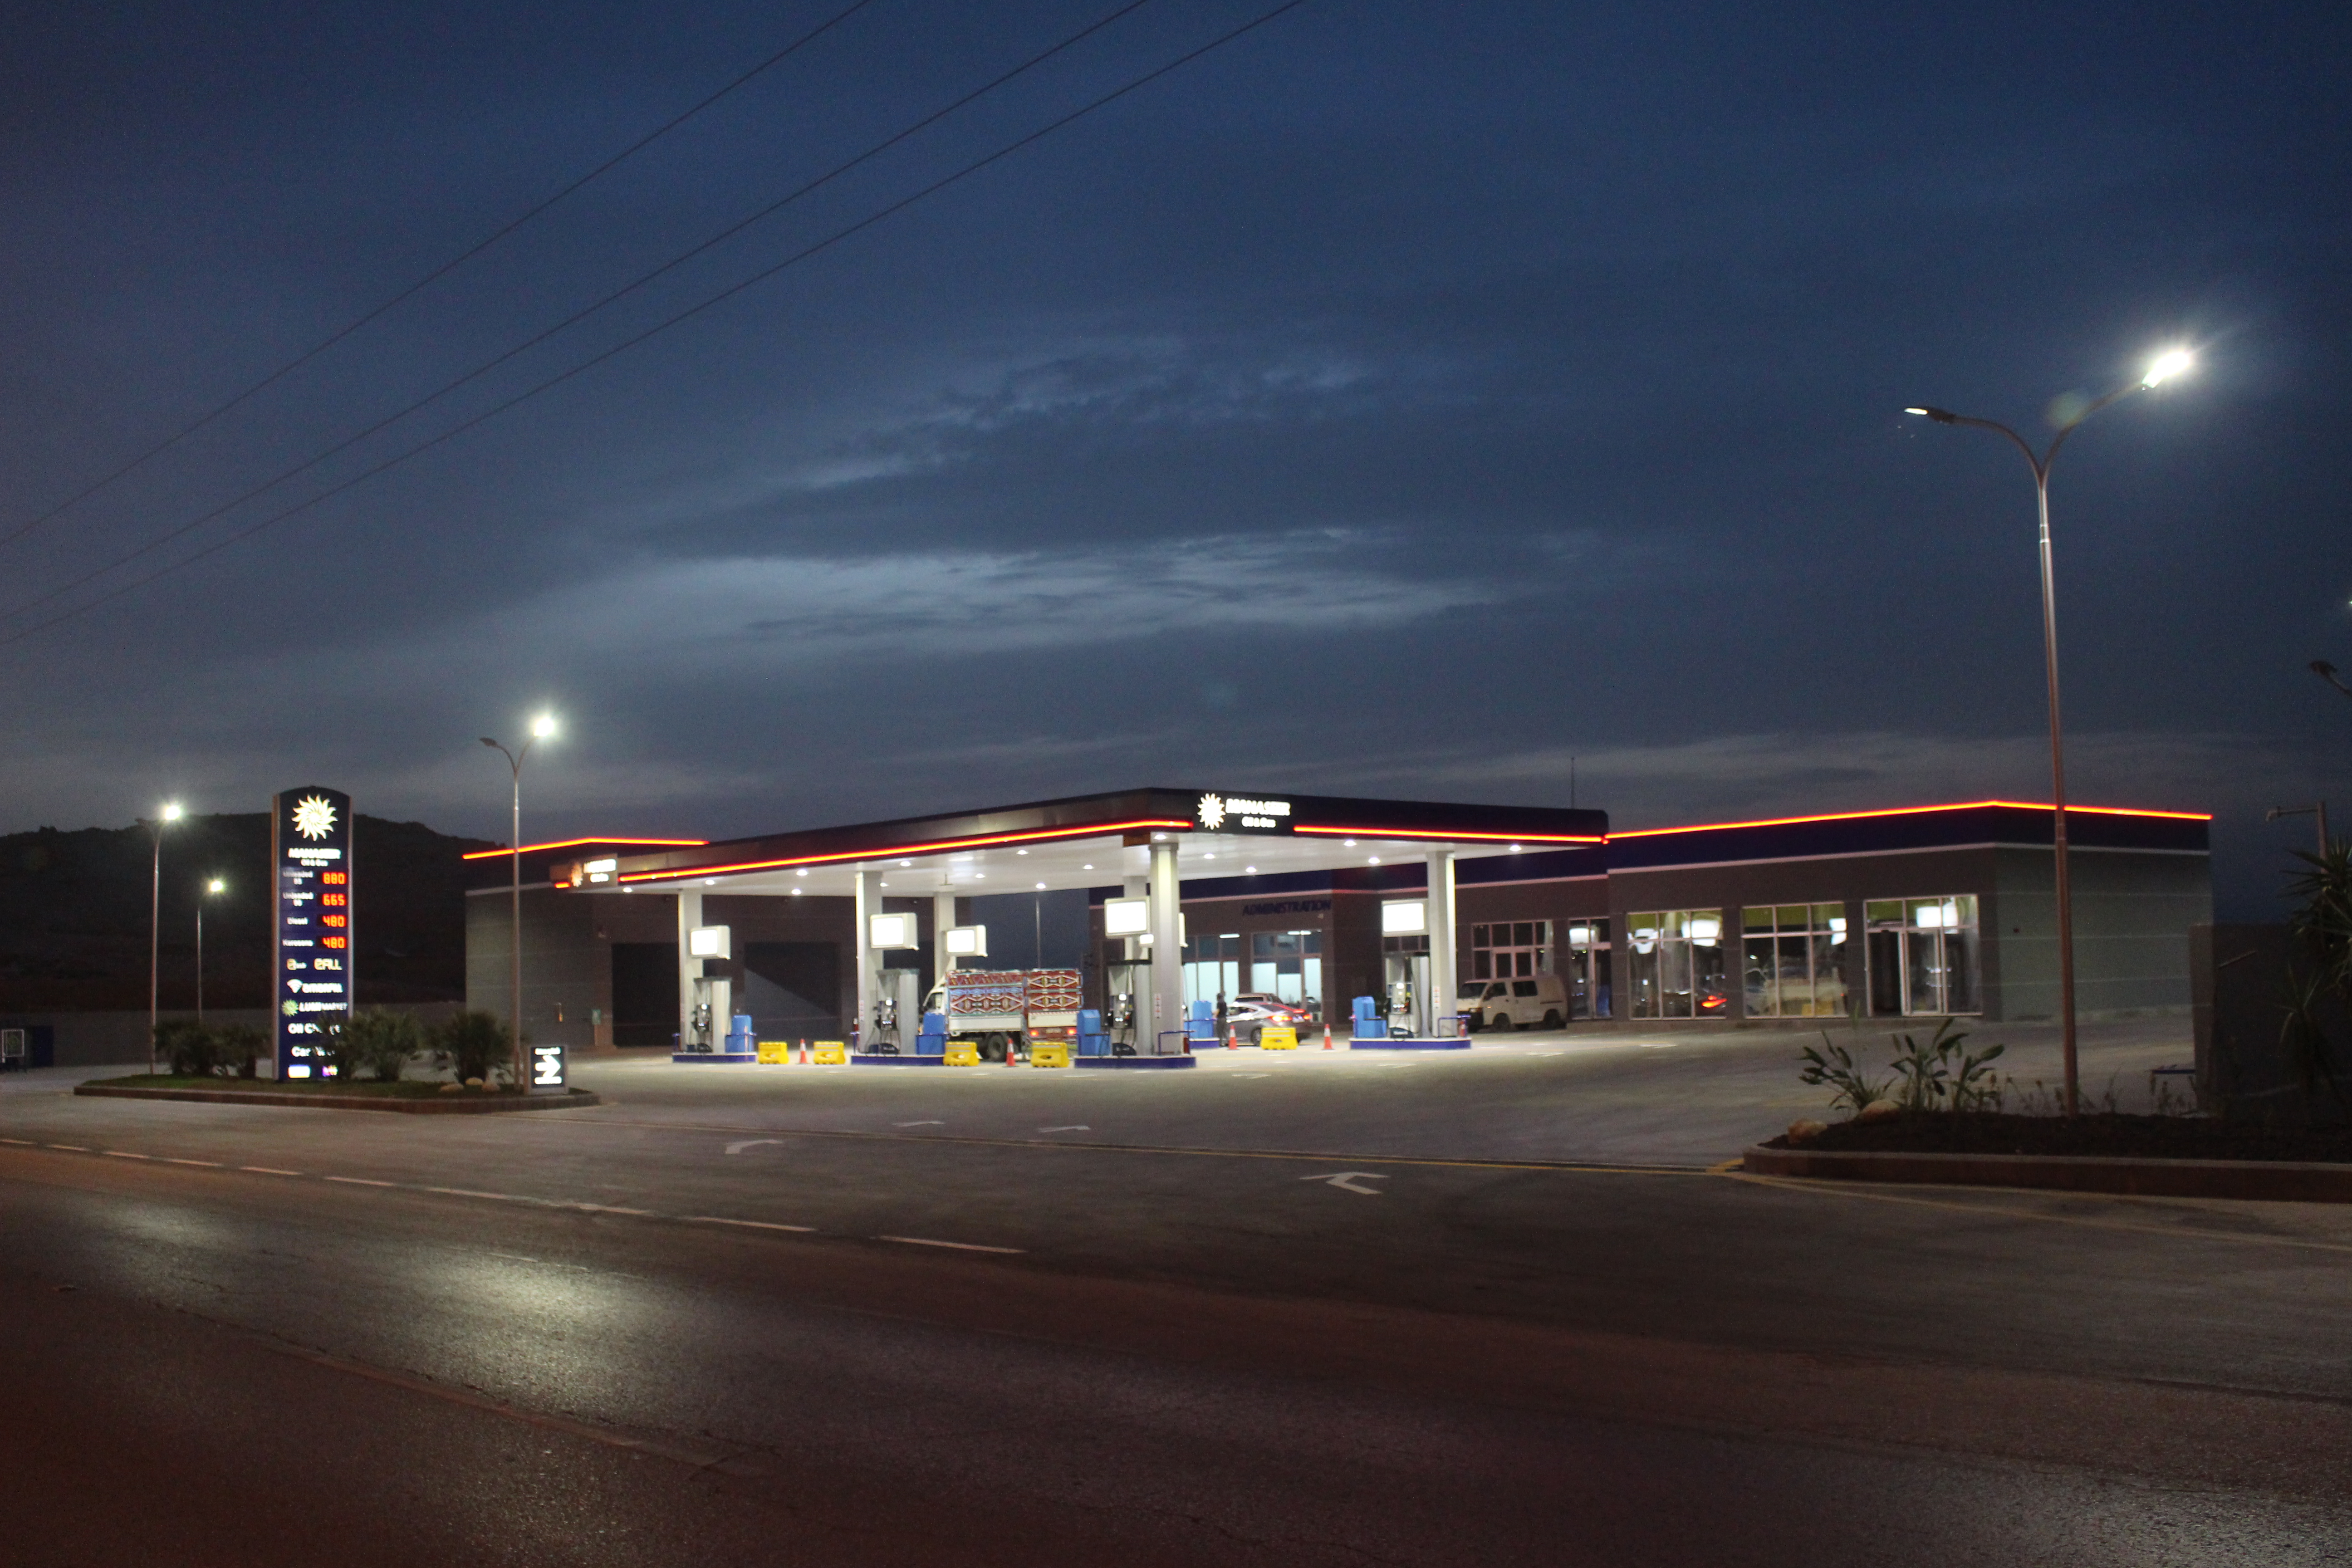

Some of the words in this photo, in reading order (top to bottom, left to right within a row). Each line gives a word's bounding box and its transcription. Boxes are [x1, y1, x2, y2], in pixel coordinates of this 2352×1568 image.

[323, 872, 347, 884] 880
[323, 893, 346, 906] 665
[323, 914, 346, 927] 480
[323, 936, 346, 949] 480
